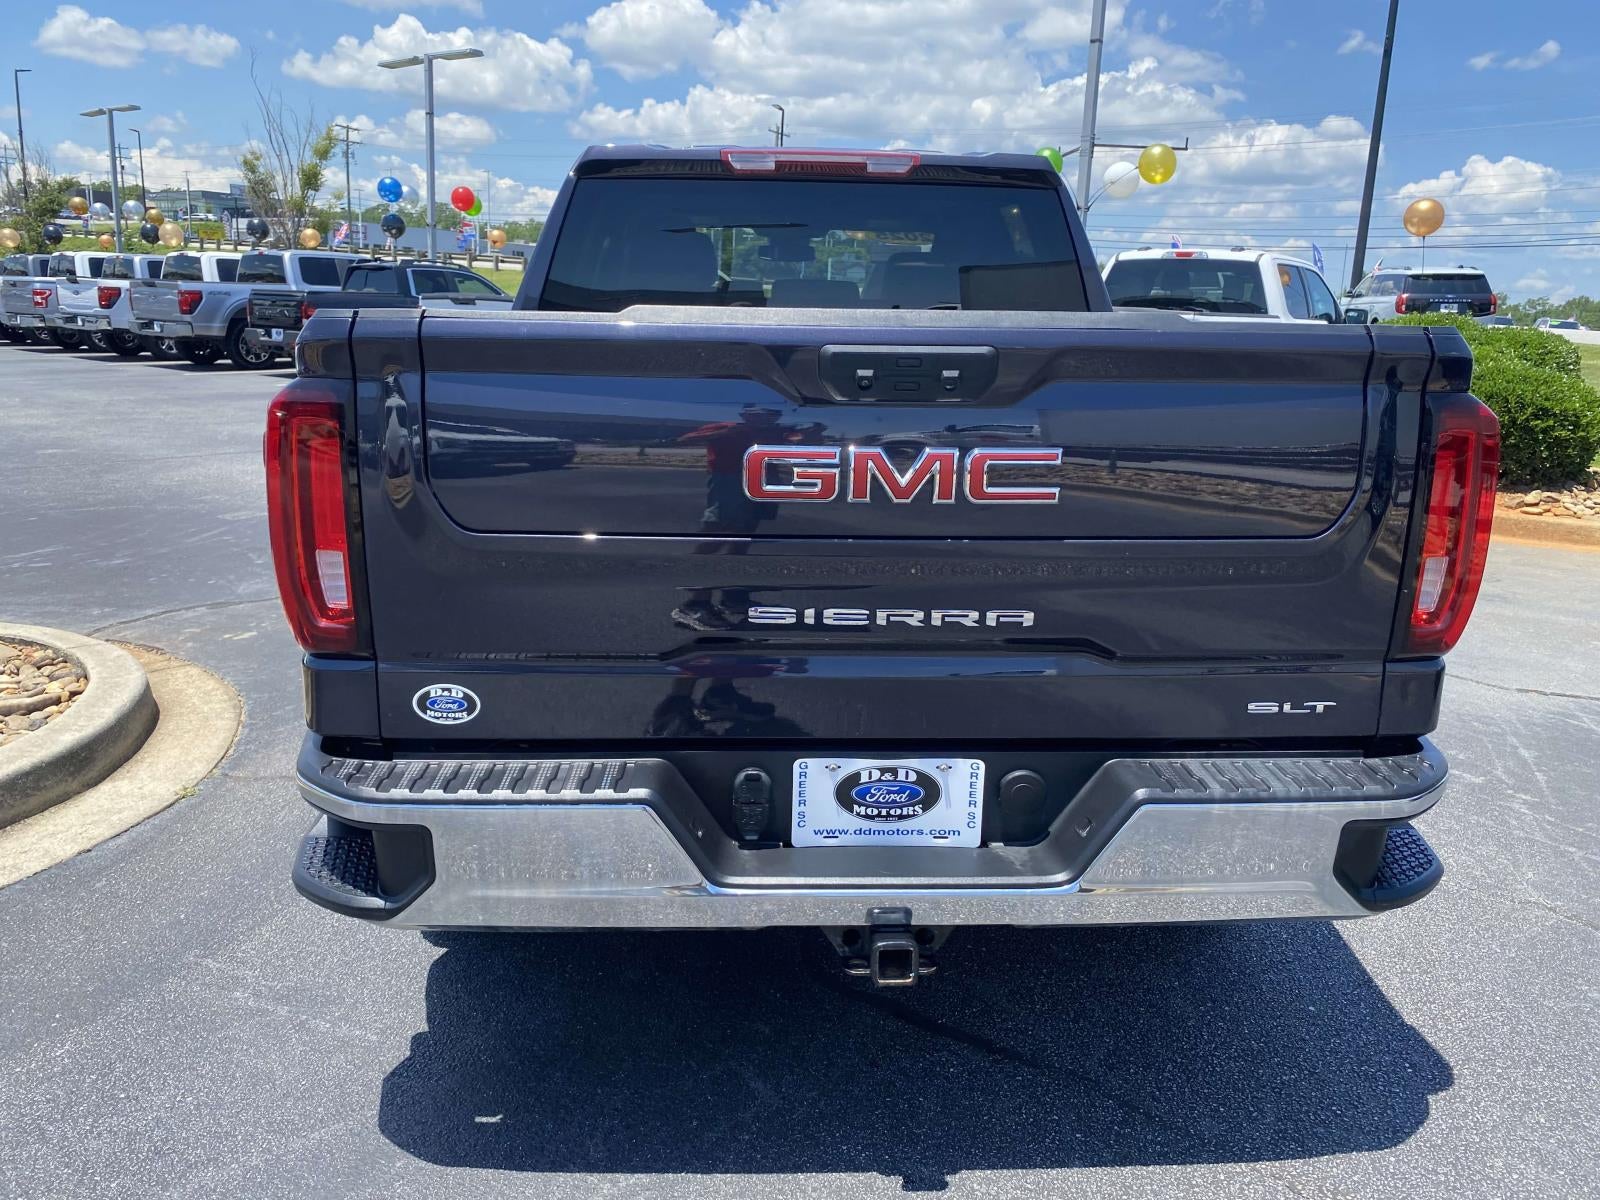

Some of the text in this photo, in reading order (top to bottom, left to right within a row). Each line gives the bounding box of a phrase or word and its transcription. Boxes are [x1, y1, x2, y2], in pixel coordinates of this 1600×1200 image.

[742, 444, 1063, 504] GMC
[747, 606, 1035, 627] SIERRA
[429, 688, 464, 698] D&D
[434, 699, 459, 709] Ford
[1247, 701, 1337, 713] SLT
[426, 709, 468, 718] MOTORS
[859, 768, 917, 783] D&D
[797, 761, 808, 828] GREER SC
[865, 786, 910, 803] Ford
[967, 762, 980, 829] GREER SC
[852, 803, 923, 816] MOTORS
[813, 828, 961, 837] www.ddmotors.com
